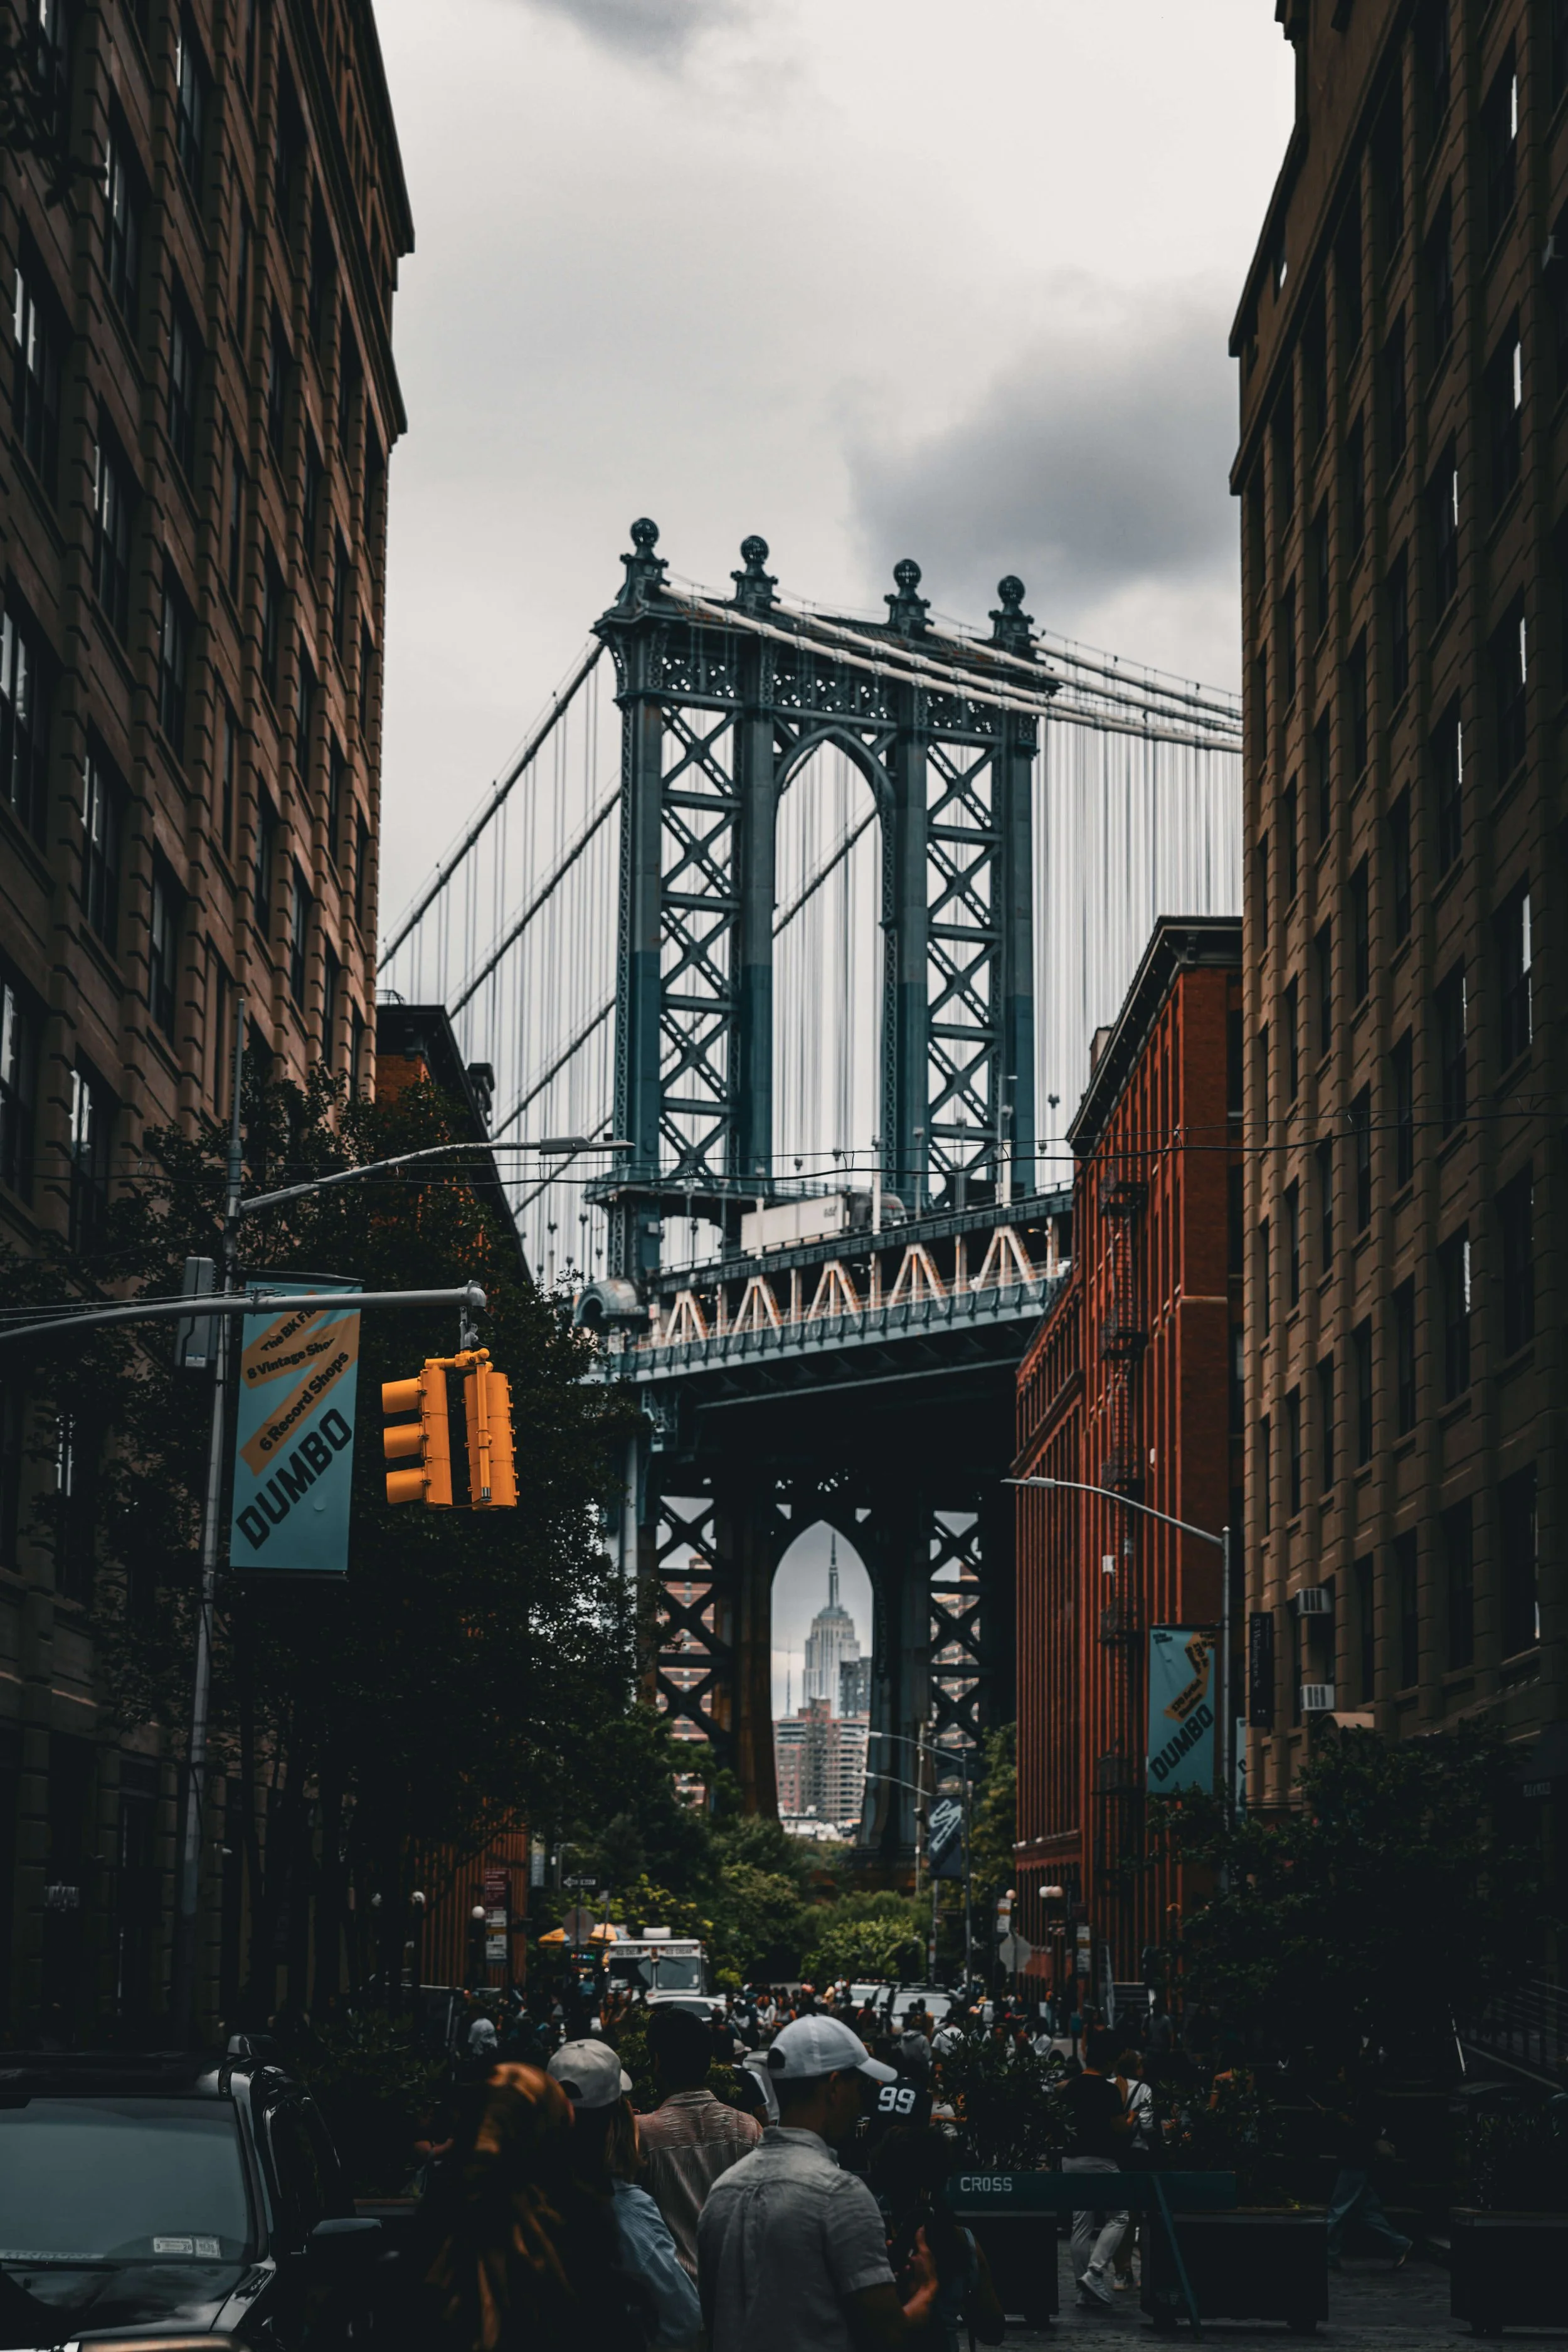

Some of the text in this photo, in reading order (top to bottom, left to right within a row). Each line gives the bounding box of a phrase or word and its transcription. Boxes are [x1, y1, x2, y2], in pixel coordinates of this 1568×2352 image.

[280, 1318, 301, 1338] BK
[247, 1367, 257, 1379] 8
[256, 1350, 305, 1375] Vintage
[260, 1352, 349, 1451] 6 Record Shops
[236, 1409, 352, 1550] DUMBO
[1150, 1703, 1214, 1783] DUMBO
[877, 2086, 916, 2114] 99
[960, 2177, 1012, 2192] CROSS
